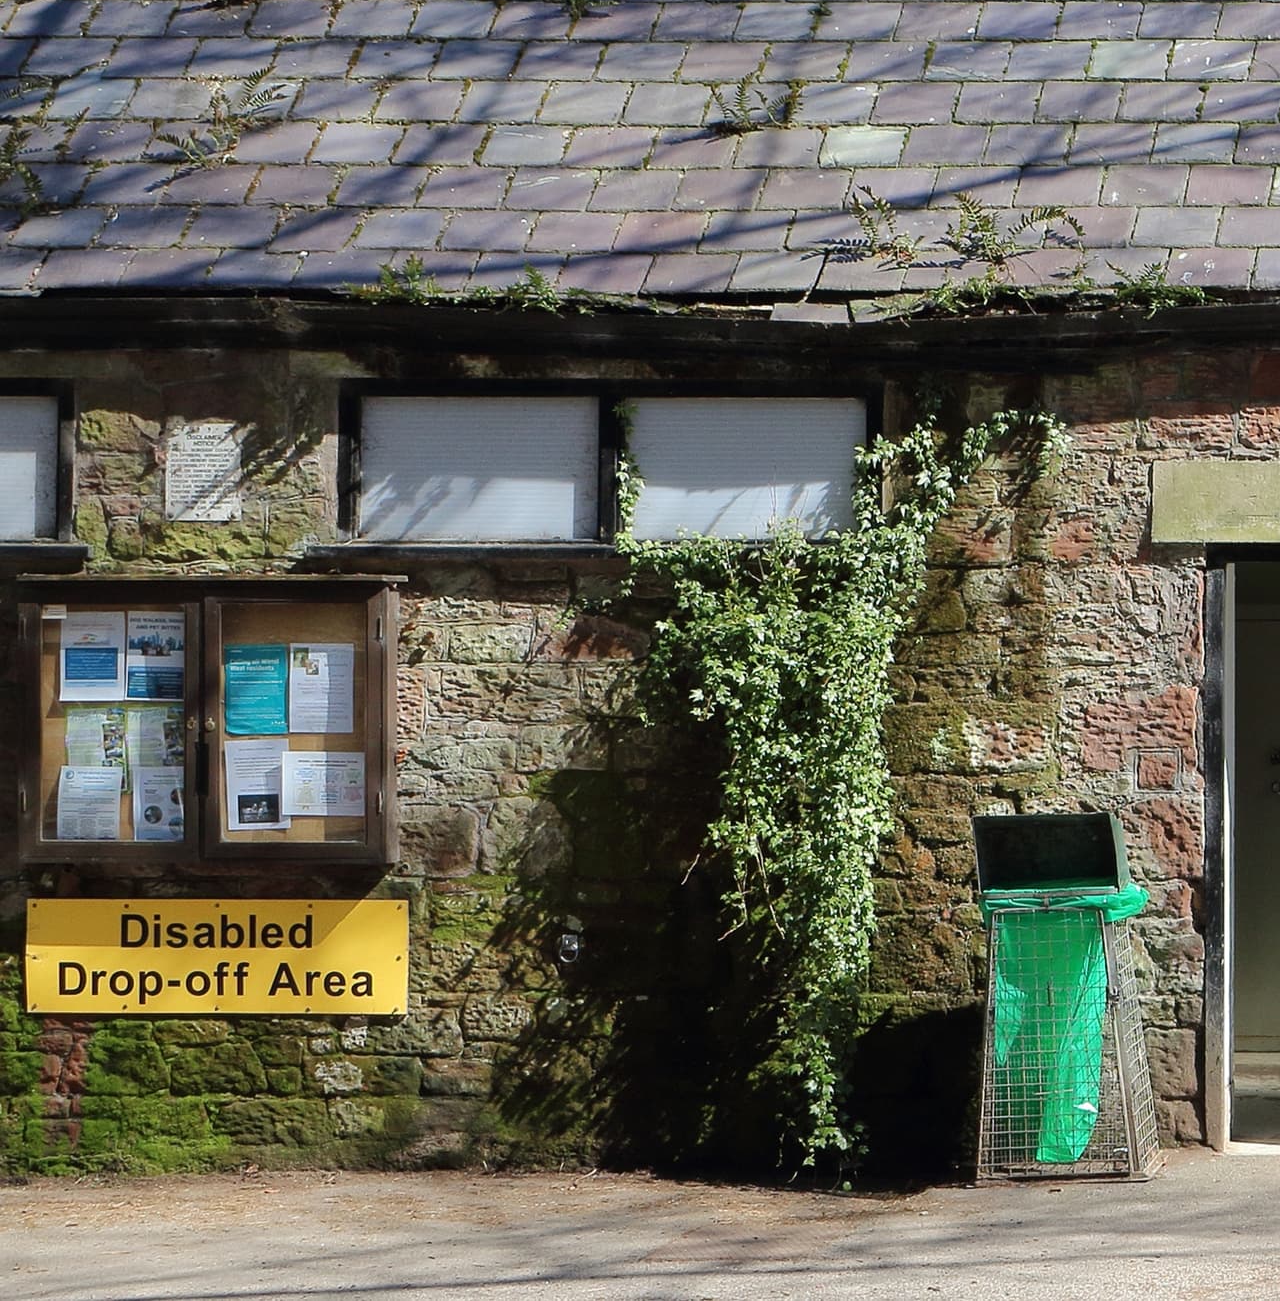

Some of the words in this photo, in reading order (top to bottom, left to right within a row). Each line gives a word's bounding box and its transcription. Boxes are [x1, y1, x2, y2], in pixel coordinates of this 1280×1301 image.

[120, 914, 314, 949] Disabled
[58, 962, 249, 1004] Drop-off
[268, 962, 374, 996] Area
